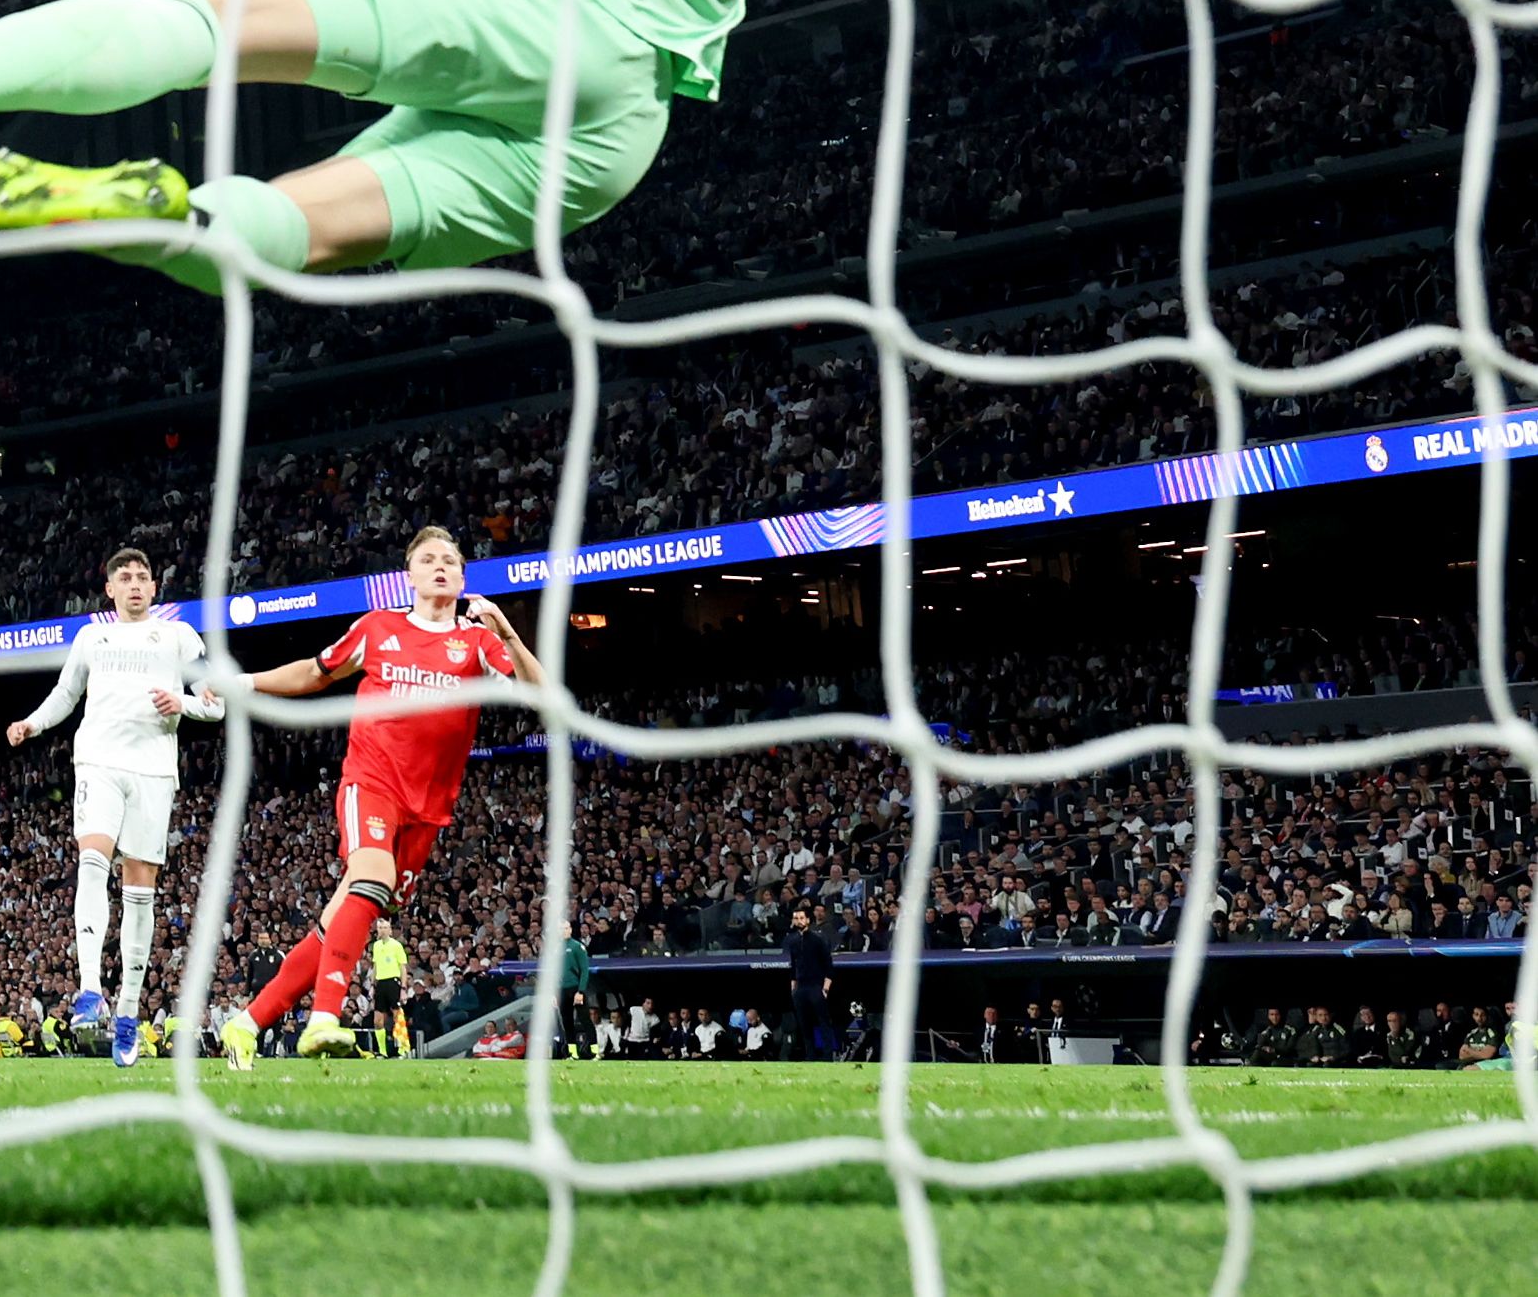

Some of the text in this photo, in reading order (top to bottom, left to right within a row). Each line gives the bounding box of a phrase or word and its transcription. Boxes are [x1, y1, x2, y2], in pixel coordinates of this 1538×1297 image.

[1413, 430, 1471, 461] REAL
[967, 492, 1046, 521] Heineken
[507, 534, 723, 584] UEFA CHAMPIONS LEAGUE
[258, 591, 317, 614] mastercard
[14, 625, 64, 649] LEAGUE
[381, 662, 462, 691] Emirates
[77, 781, 89, 805] 8
